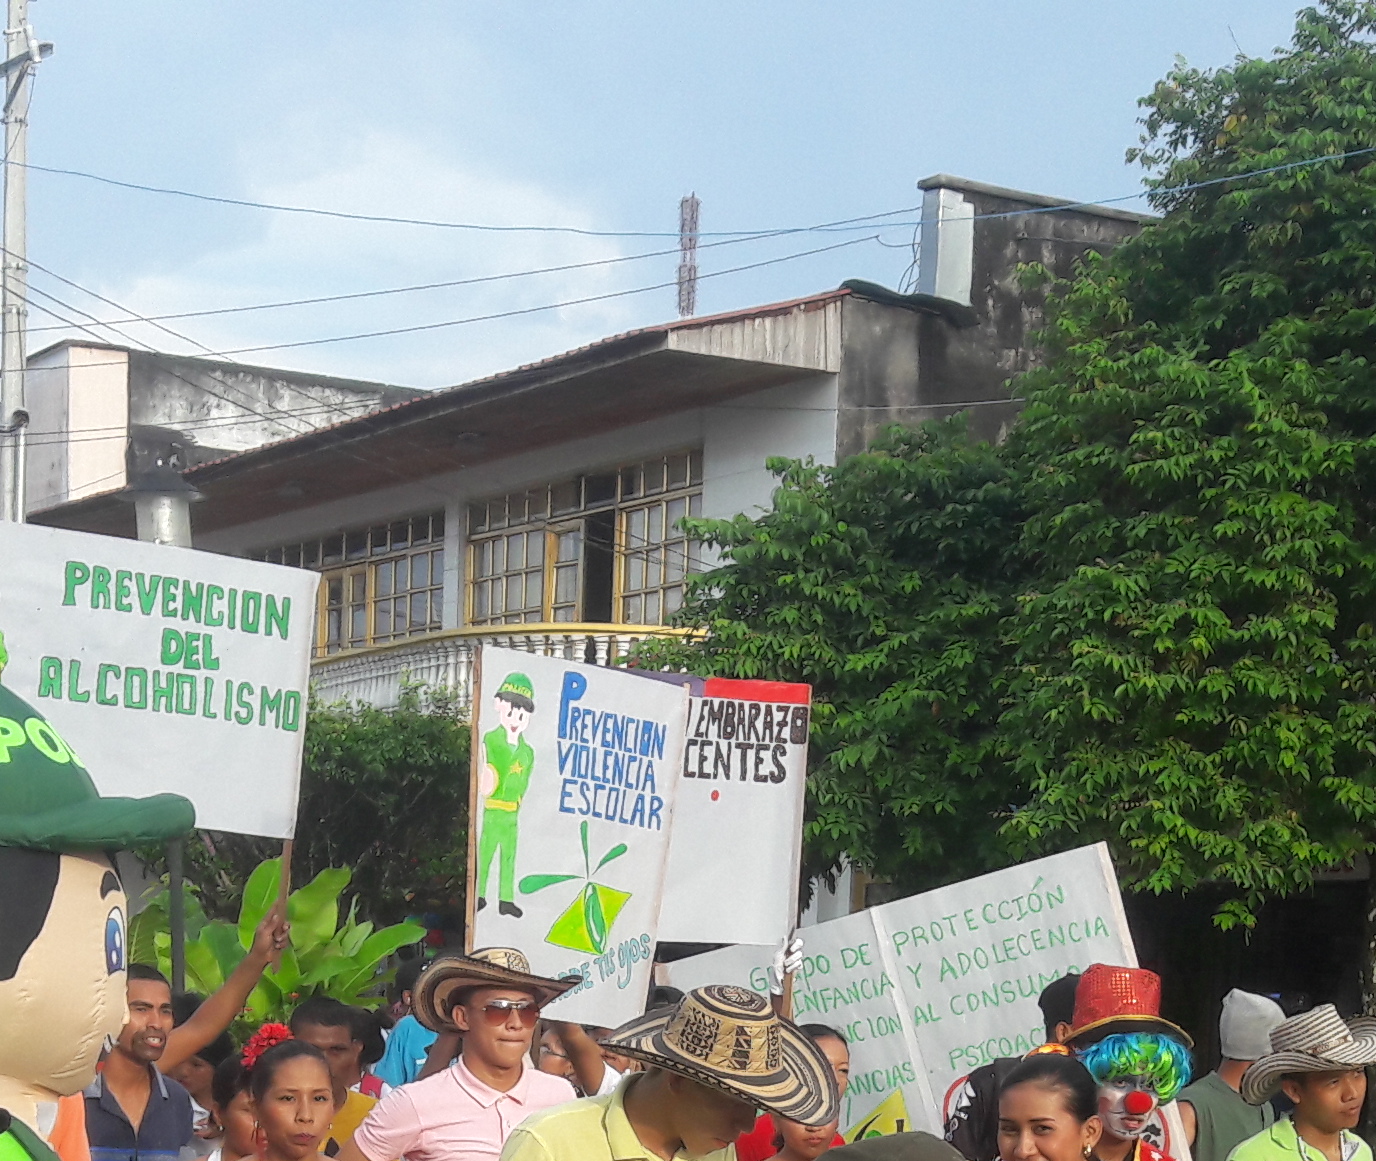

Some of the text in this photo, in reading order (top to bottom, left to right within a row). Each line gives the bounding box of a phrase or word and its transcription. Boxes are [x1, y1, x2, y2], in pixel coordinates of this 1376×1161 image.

[62, 561, 292, 640] PREVENCION
[161, 627, 220, 671] DEL
[38, 656, 302, 732] ALCOHOLISMO
[557, 671, 667, 761] PREVENCION
[693, 698, 808, 745] EMBARAZO
[557, 740, 656, 794] VIOLENCIA
[683, 739, 787, 783] CENTES
[558, 778, 665, 831] ESCOLAR
[839, 943, 873, 969] DE
[892, 875, 1066, 956] PROTECCIÓN
[793, 915, 1110, 1018] INFANCIA Y ADOLECENCIA
[914, 1003, 942, 1027] AL
